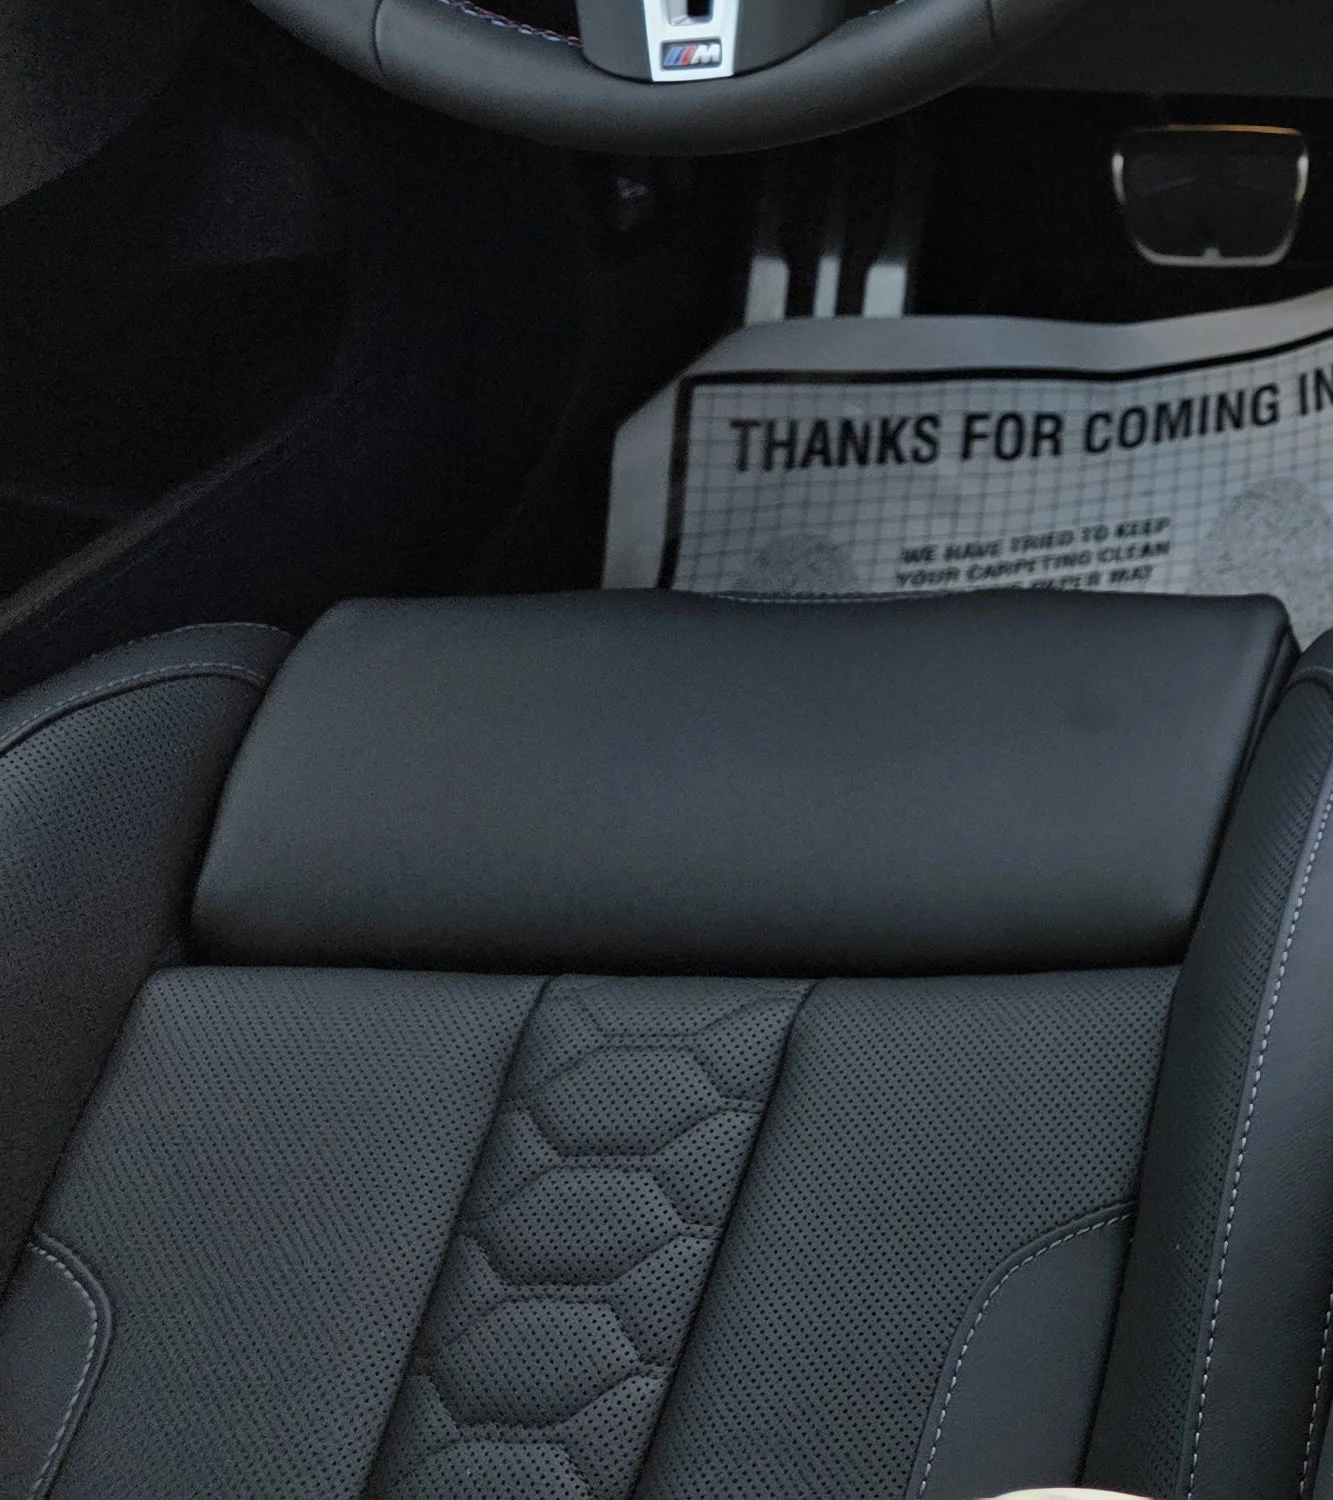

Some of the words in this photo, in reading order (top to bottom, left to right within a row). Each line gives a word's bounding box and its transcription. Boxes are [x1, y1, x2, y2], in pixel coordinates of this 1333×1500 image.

[729, 412, 941, 472] THANKS
[960, 411, 1064, 462] FOR
[1083, 381, 1280, 454] COMING
[896, 566, 960, 587] YOUR
[966, 549, 1092, 583] CARPETING
[1096, 539, 1171, 563] CLEAN
[900, 543, 938, 564] WE
[945, 541, 1001, 561] HAVE
[1010, 529, 1075, 552] TRIED
[1081, 523, 1109, 543] TO
[1114, 516, 1172, 538] KEEP
